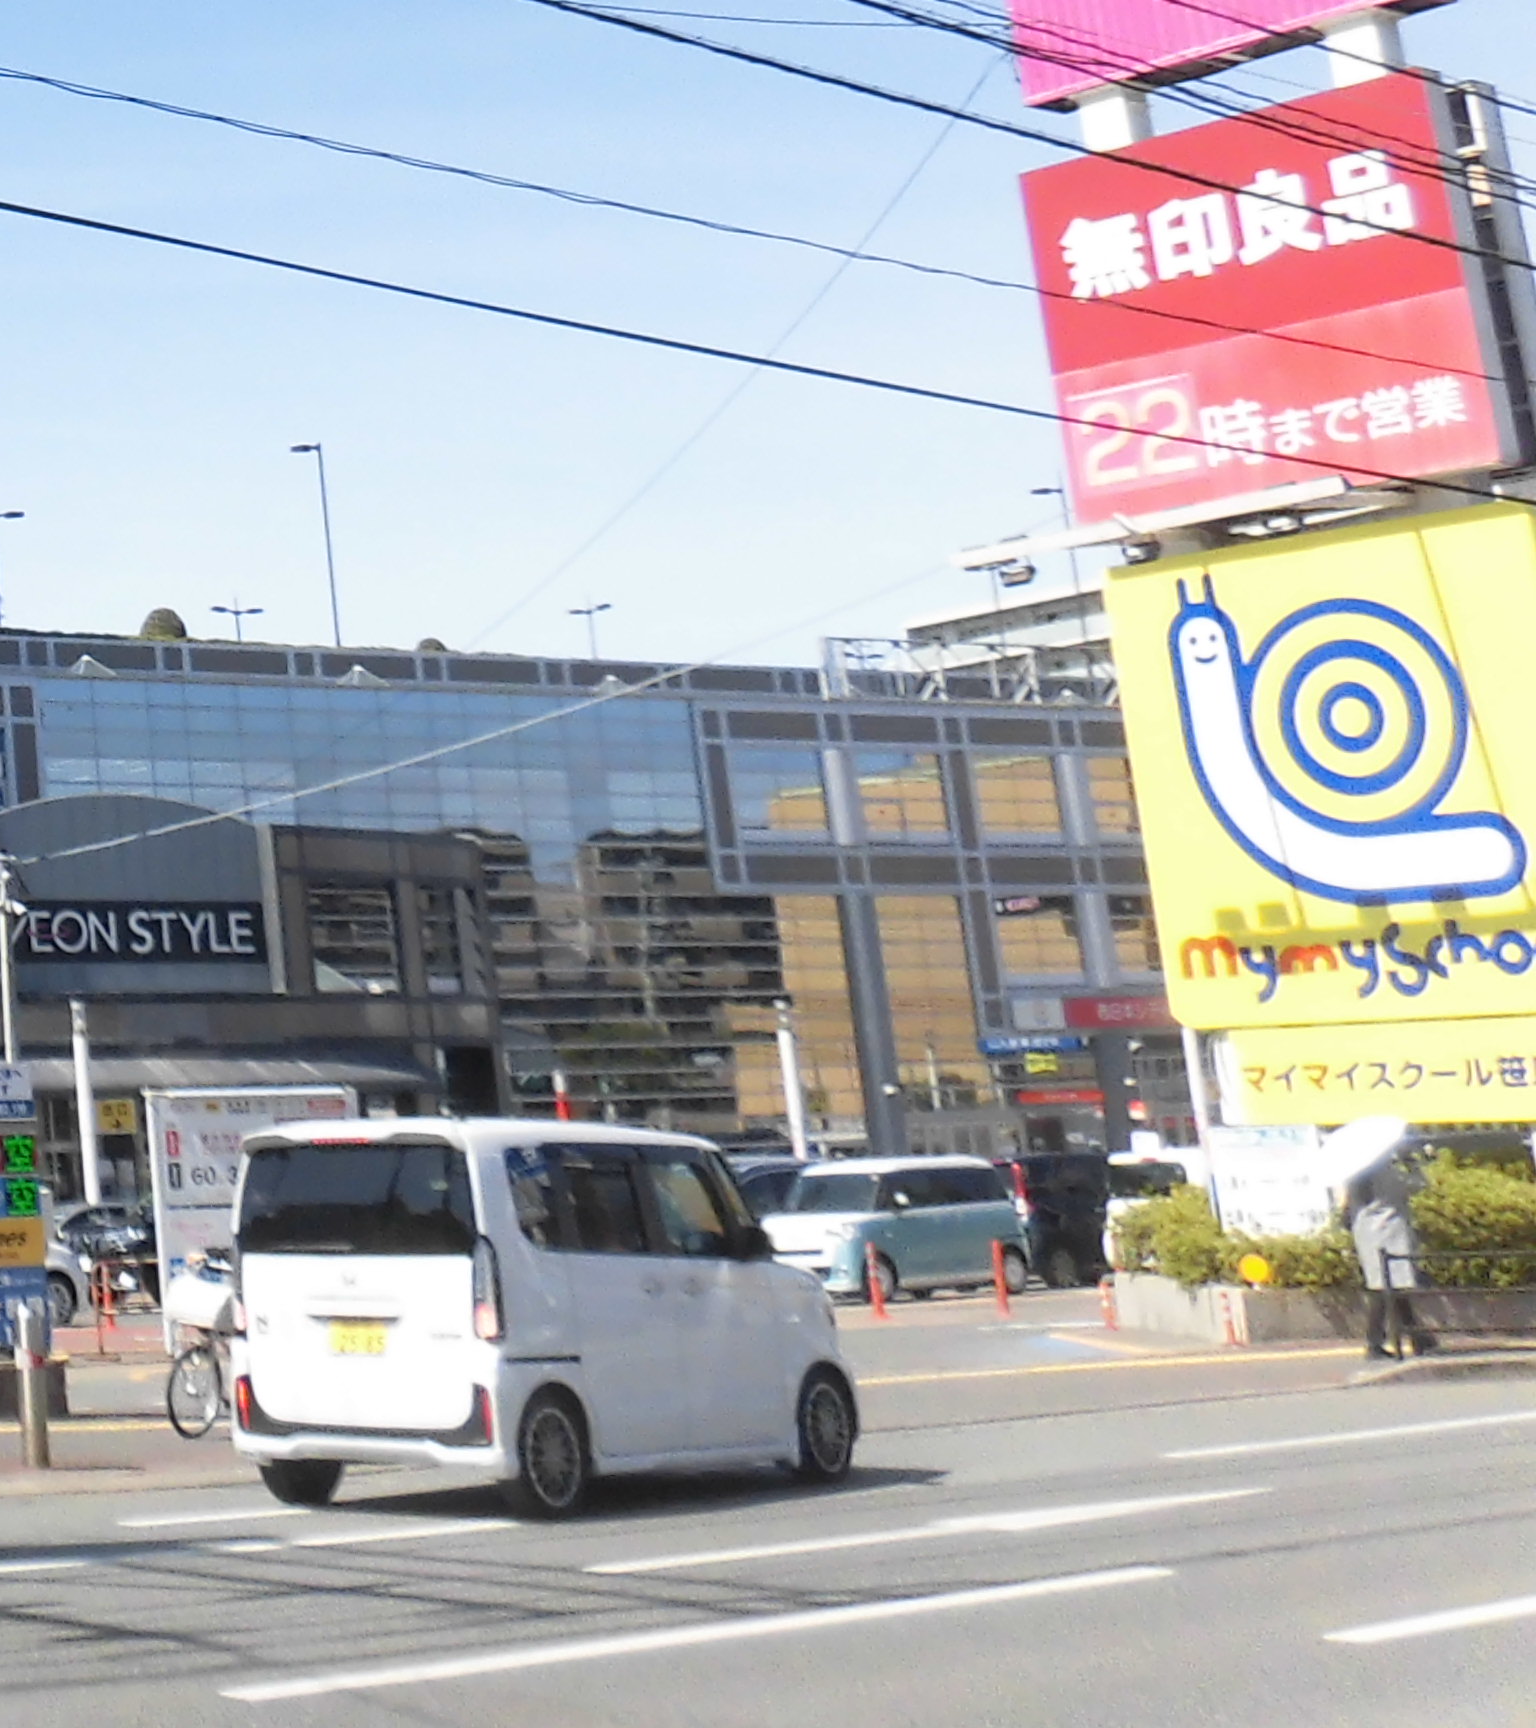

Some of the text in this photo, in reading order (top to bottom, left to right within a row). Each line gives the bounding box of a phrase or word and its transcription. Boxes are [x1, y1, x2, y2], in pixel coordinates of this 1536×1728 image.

[1057, 149, 1417, 302] 無印良品
[1079, 375, 1470, 489] 22時まで営業
[128, 910, 256, 954] STYLE
[1181, 918, 1536, 1003] mymyScho
[1243, 1056, 1536, 1093] マイマイスクール笹
